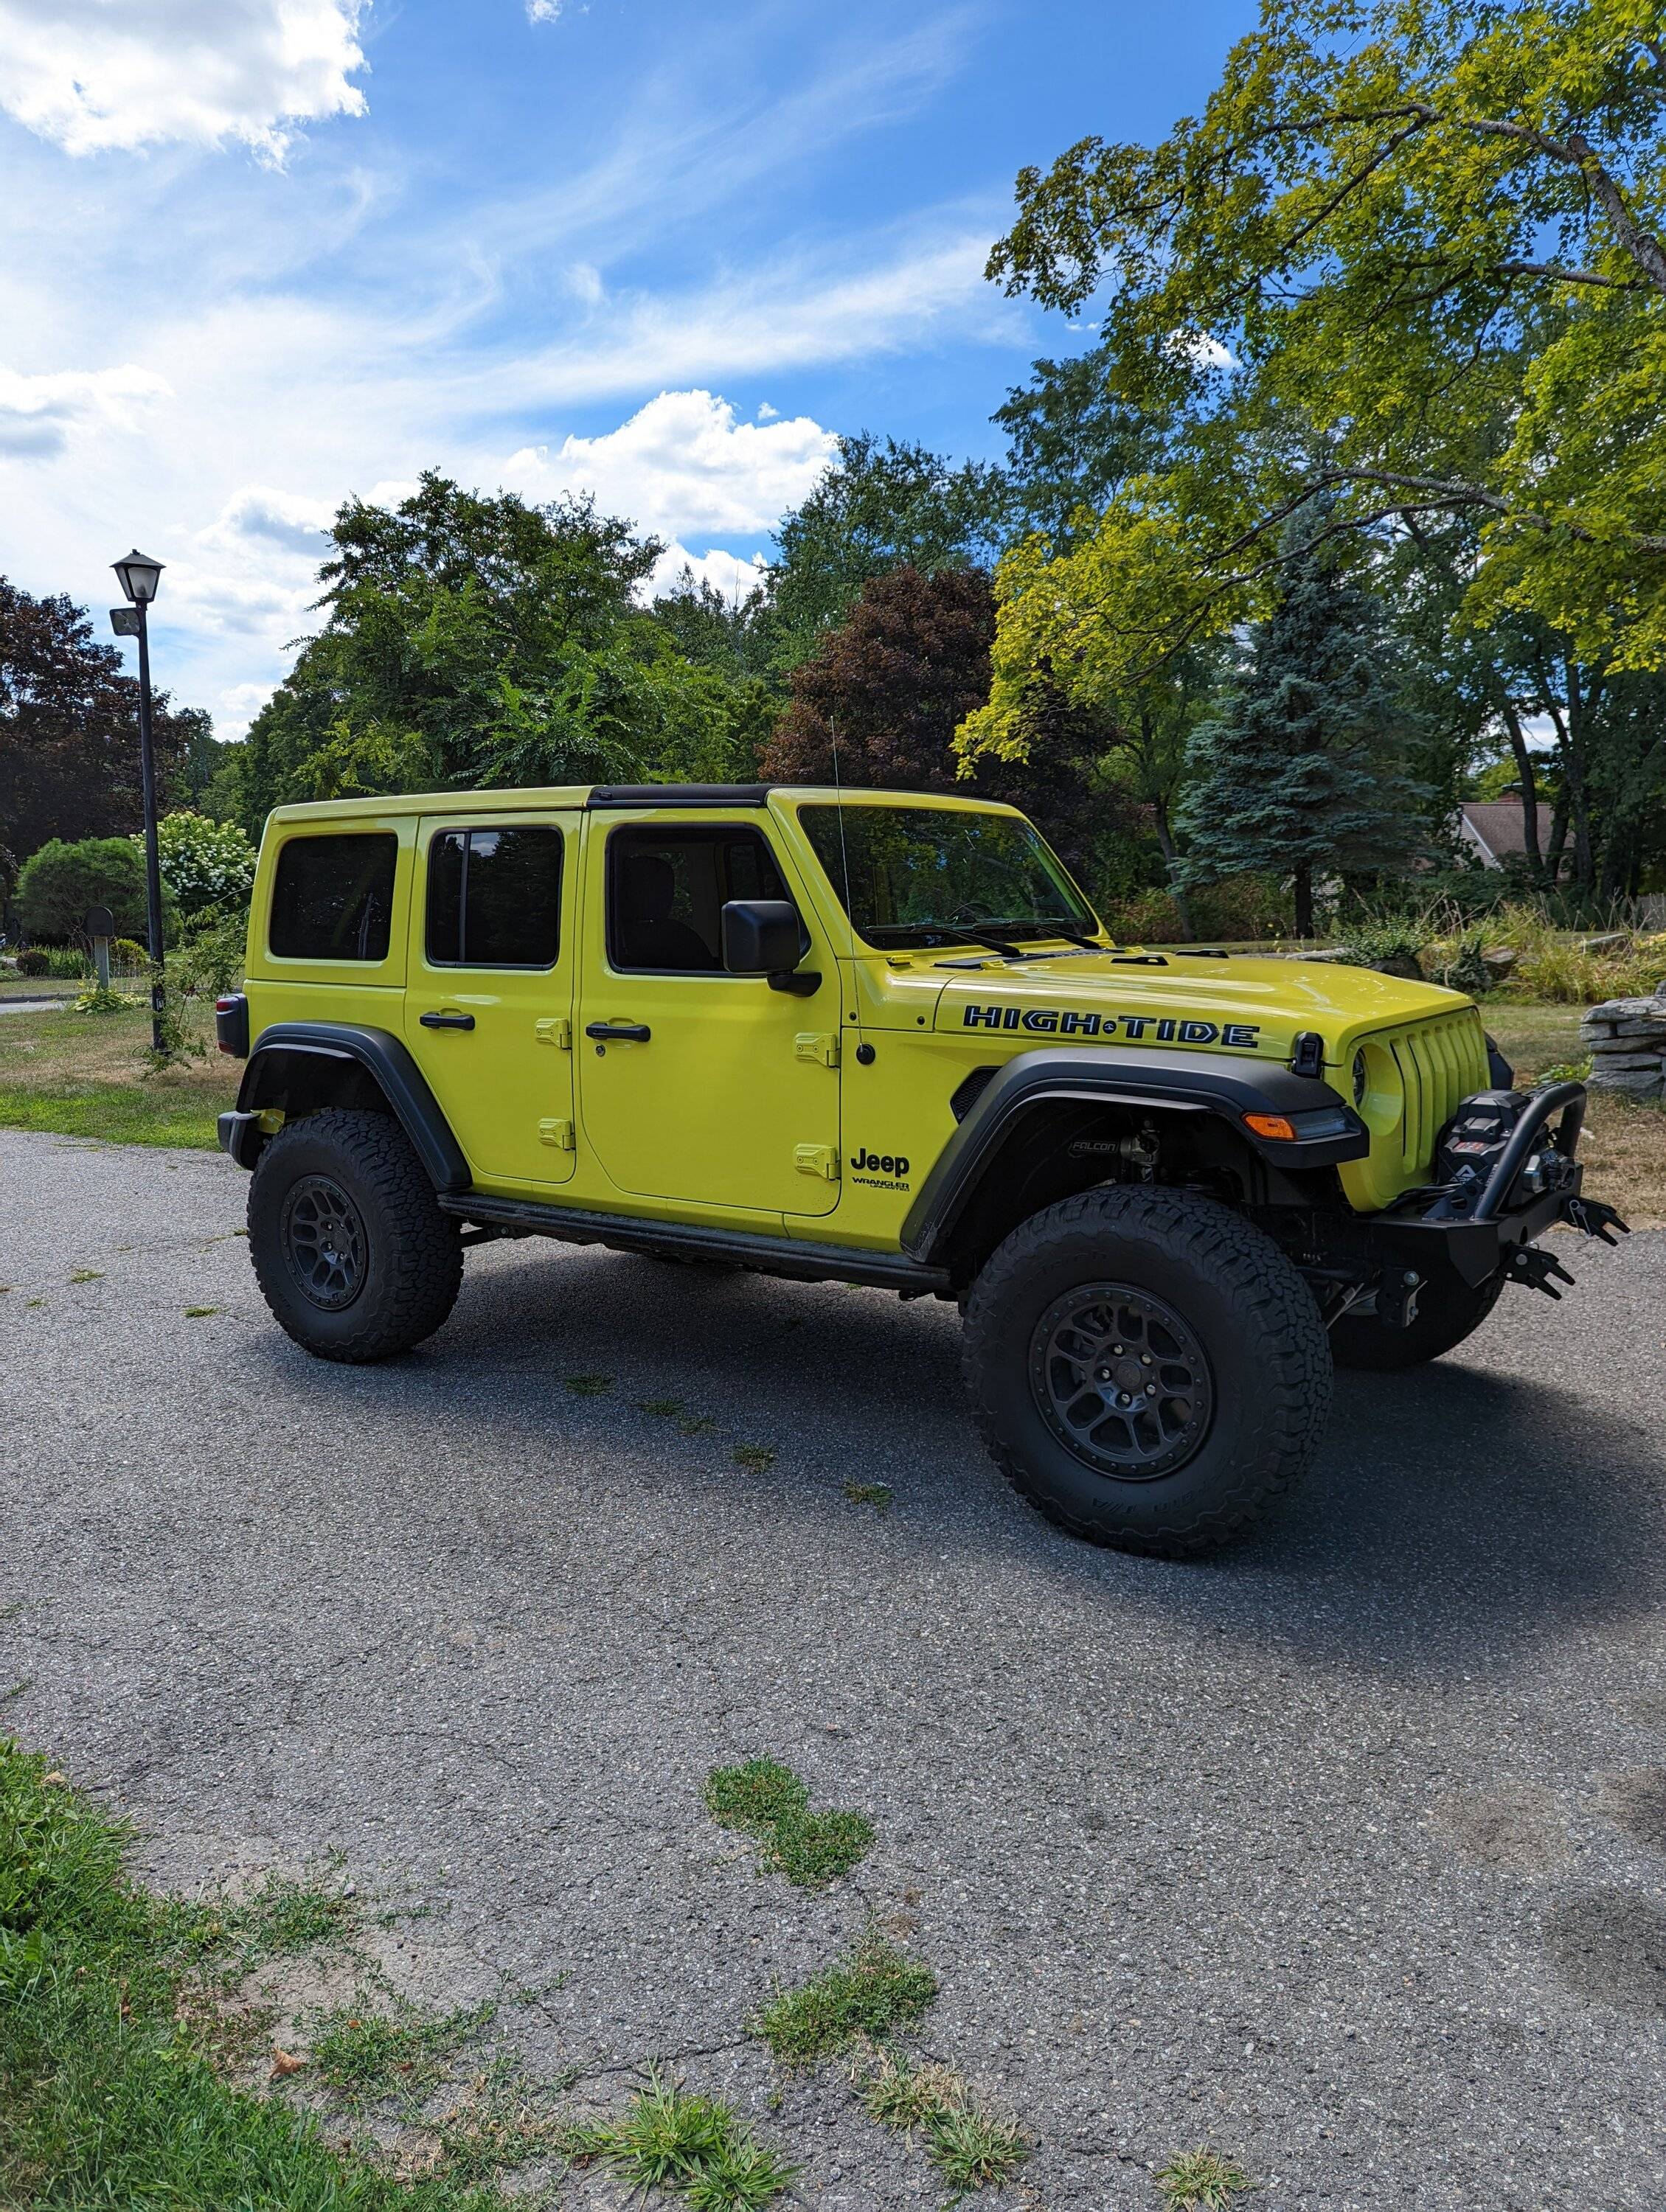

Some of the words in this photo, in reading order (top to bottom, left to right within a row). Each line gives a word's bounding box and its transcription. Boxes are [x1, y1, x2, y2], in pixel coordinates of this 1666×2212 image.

[963, 1005, 1102, 1036] HIGH
[1118, 1015, 1260, 1048] TIDE
[1072, 1141, 1117, 1151] FALCON
[850, 1147, 909, 1178] Jeep
[852, 1177, 909, 1189] WRANGLER
